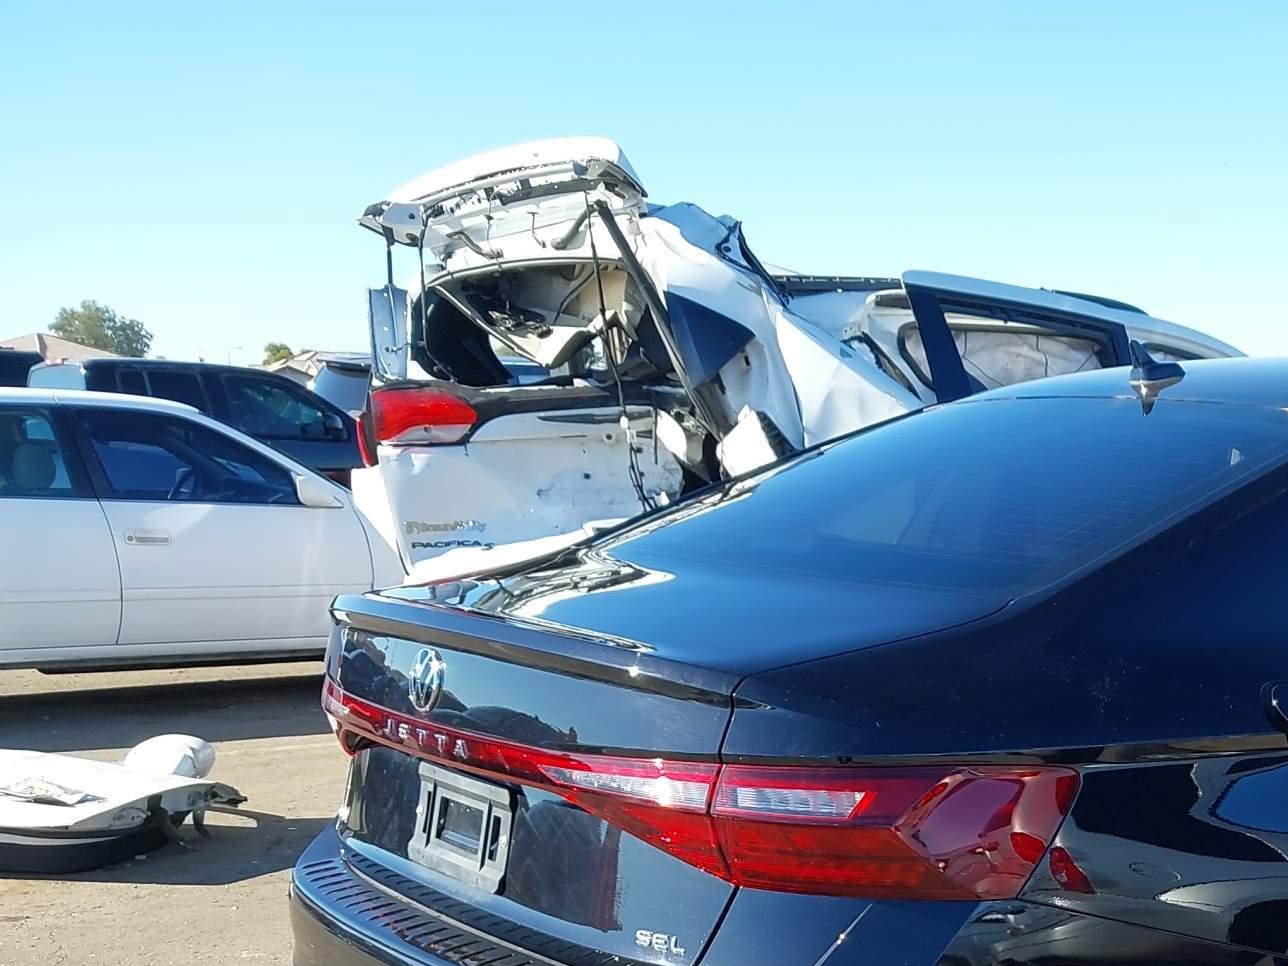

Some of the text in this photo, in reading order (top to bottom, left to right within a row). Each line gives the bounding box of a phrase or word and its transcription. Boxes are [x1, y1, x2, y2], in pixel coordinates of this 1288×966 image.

[411, 540, 482, 550] PACIFICA
[383, 719, 469, 760] JETTA
[635, 929, 686, 956] SEL
